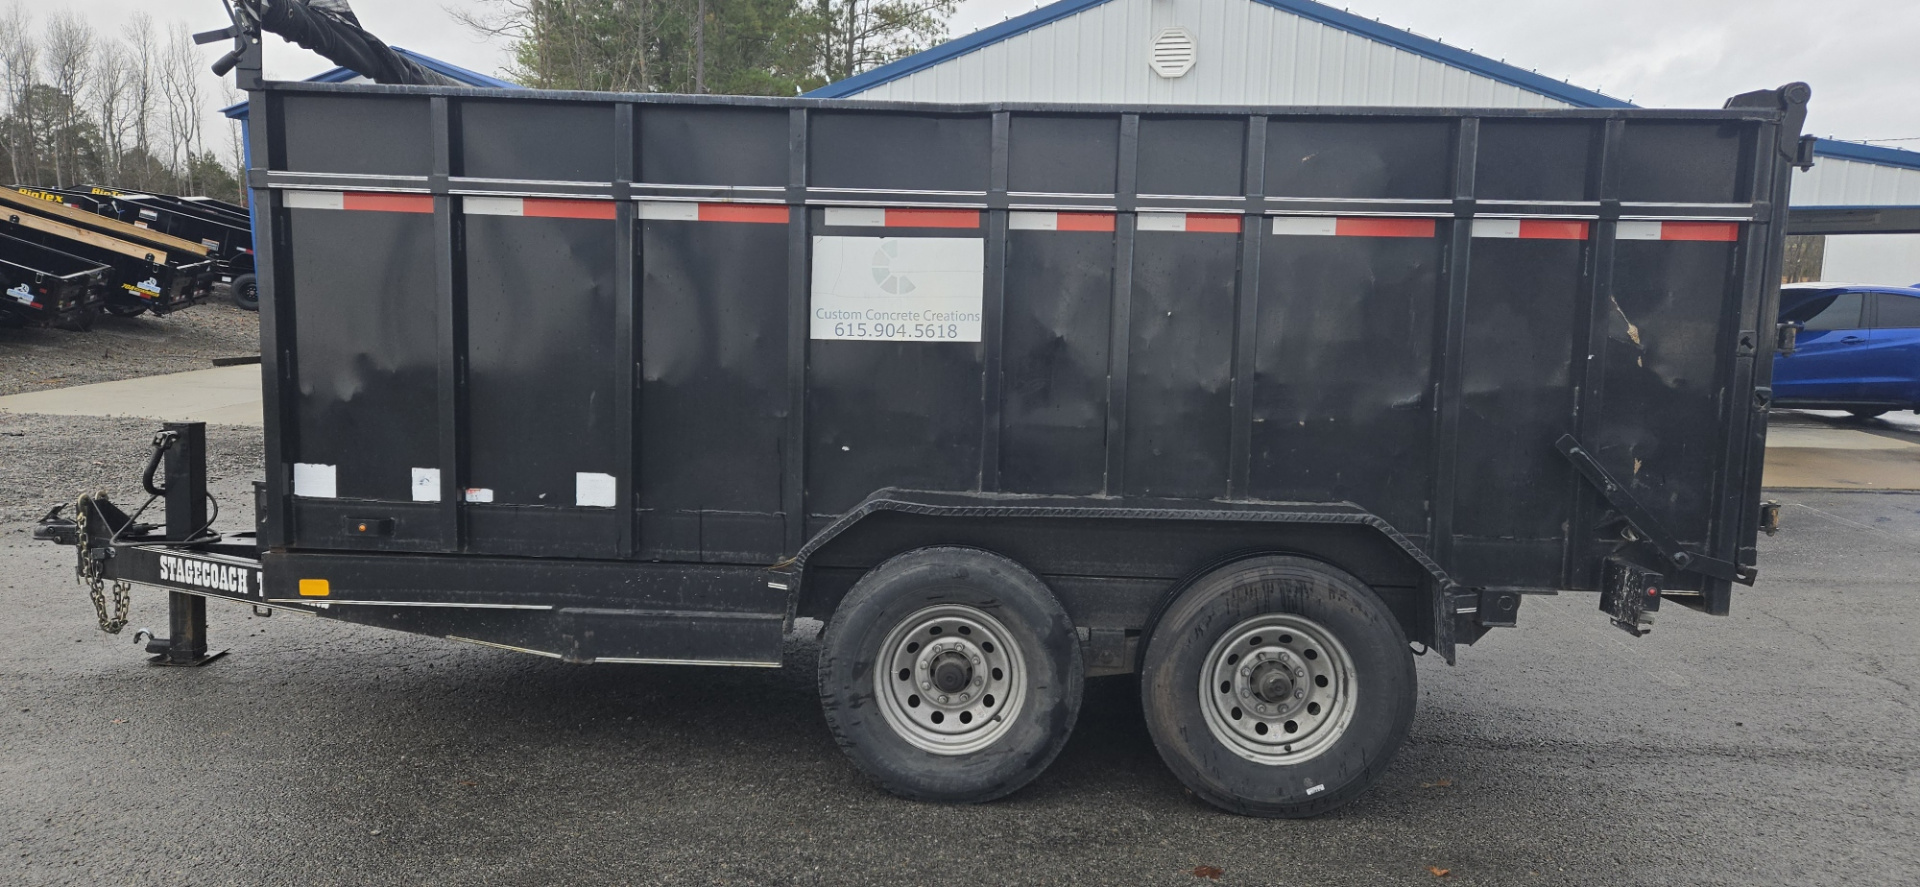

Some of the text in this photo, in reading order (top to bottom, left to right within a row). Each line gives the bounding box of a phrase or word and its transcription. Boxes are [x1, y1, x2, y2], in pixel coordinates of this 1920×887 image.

[816, 307, 980, 322] Custom Concrete Creations
[834, 322, 958, 339] 615.904.5618
[159, 555, 249, 594] STAGECOACH
